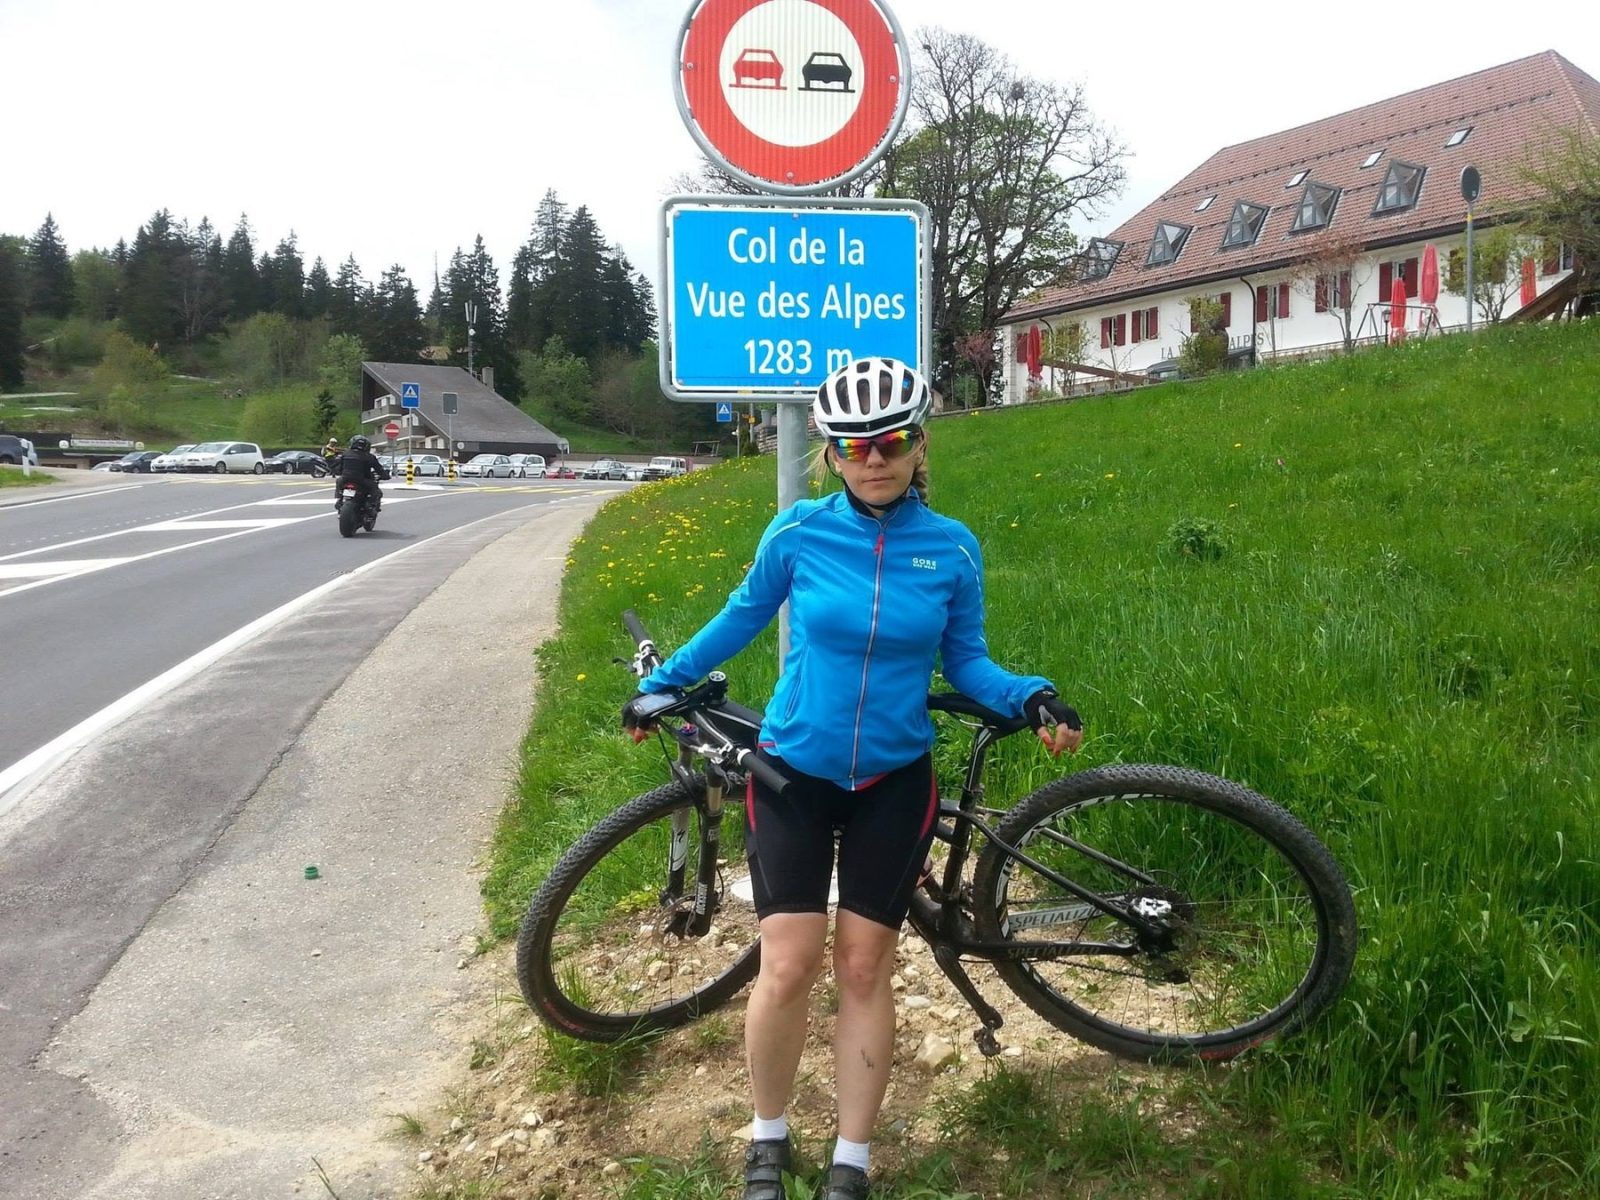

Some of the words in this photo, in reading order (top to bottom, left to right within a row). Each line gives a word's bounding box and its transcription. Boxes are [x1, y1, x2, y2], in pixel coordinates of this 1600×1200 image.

[727, 226, 776, 264] Col
[789, 227, 826, 265] de
[839, 228, 865, 266] la
[686, 282, 745, 318] Vue
[757, 281, 810, 319] des
[820, 282, 906, 329] Alpes
[744, 339, 812, 375] 1283
[826, 348, 853, 374] m
[1161, 346, 1174, 359] LA
[1229, 332, 1265, 350] ALPS
